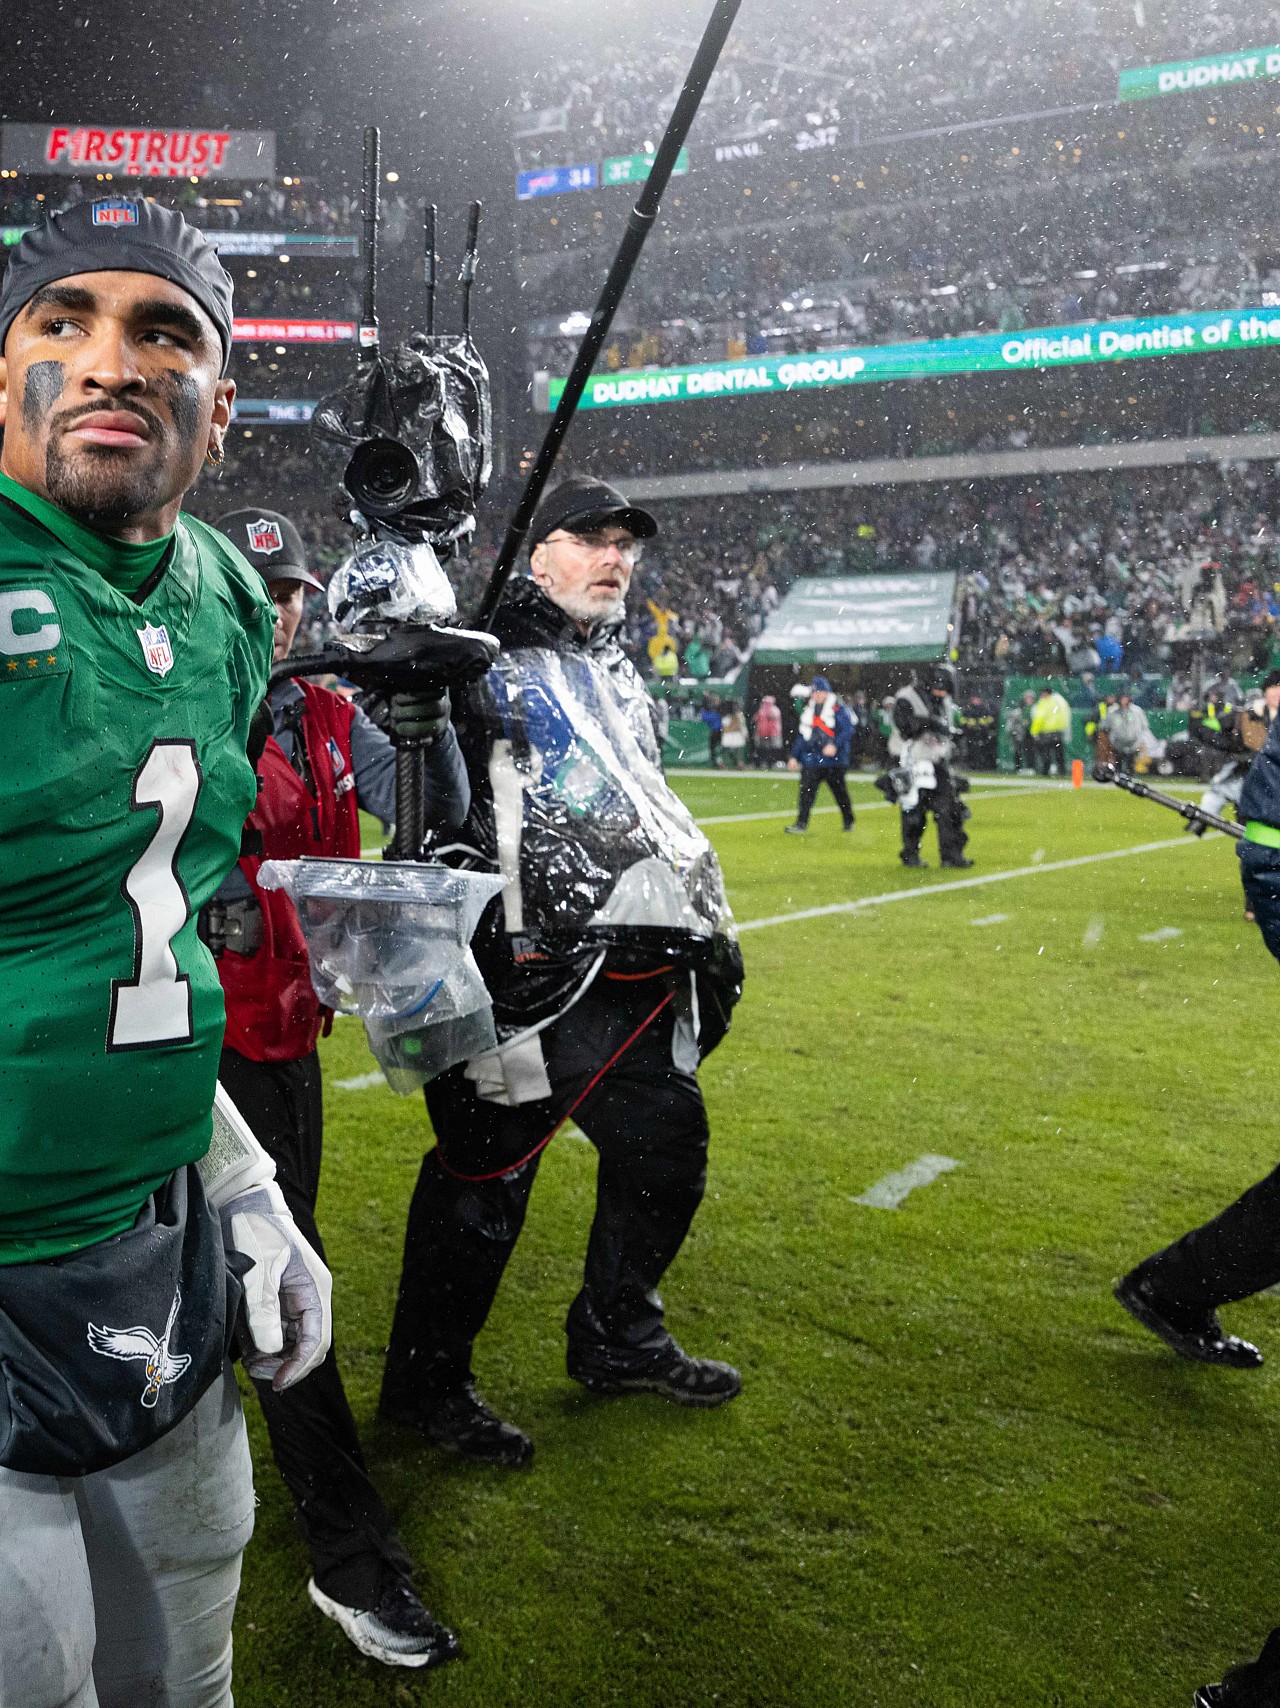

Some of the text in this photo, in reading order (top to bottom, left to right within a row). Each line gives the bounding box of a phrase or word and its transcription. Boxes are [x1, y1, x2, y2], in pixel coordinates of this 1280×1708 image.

[1158, 57, 1260, 93] DUDHAT
[97, 208, 135, 223] NFL
[1001, 315, 1280, 364] Official Dentist of the
[592, 357, 865, 403] DUDHAT DENTAL GROUP
[253, 532, 281, 549] NFL
[149, 645, 170, 667] NFL
[105, 736, 203, 1054] 1
